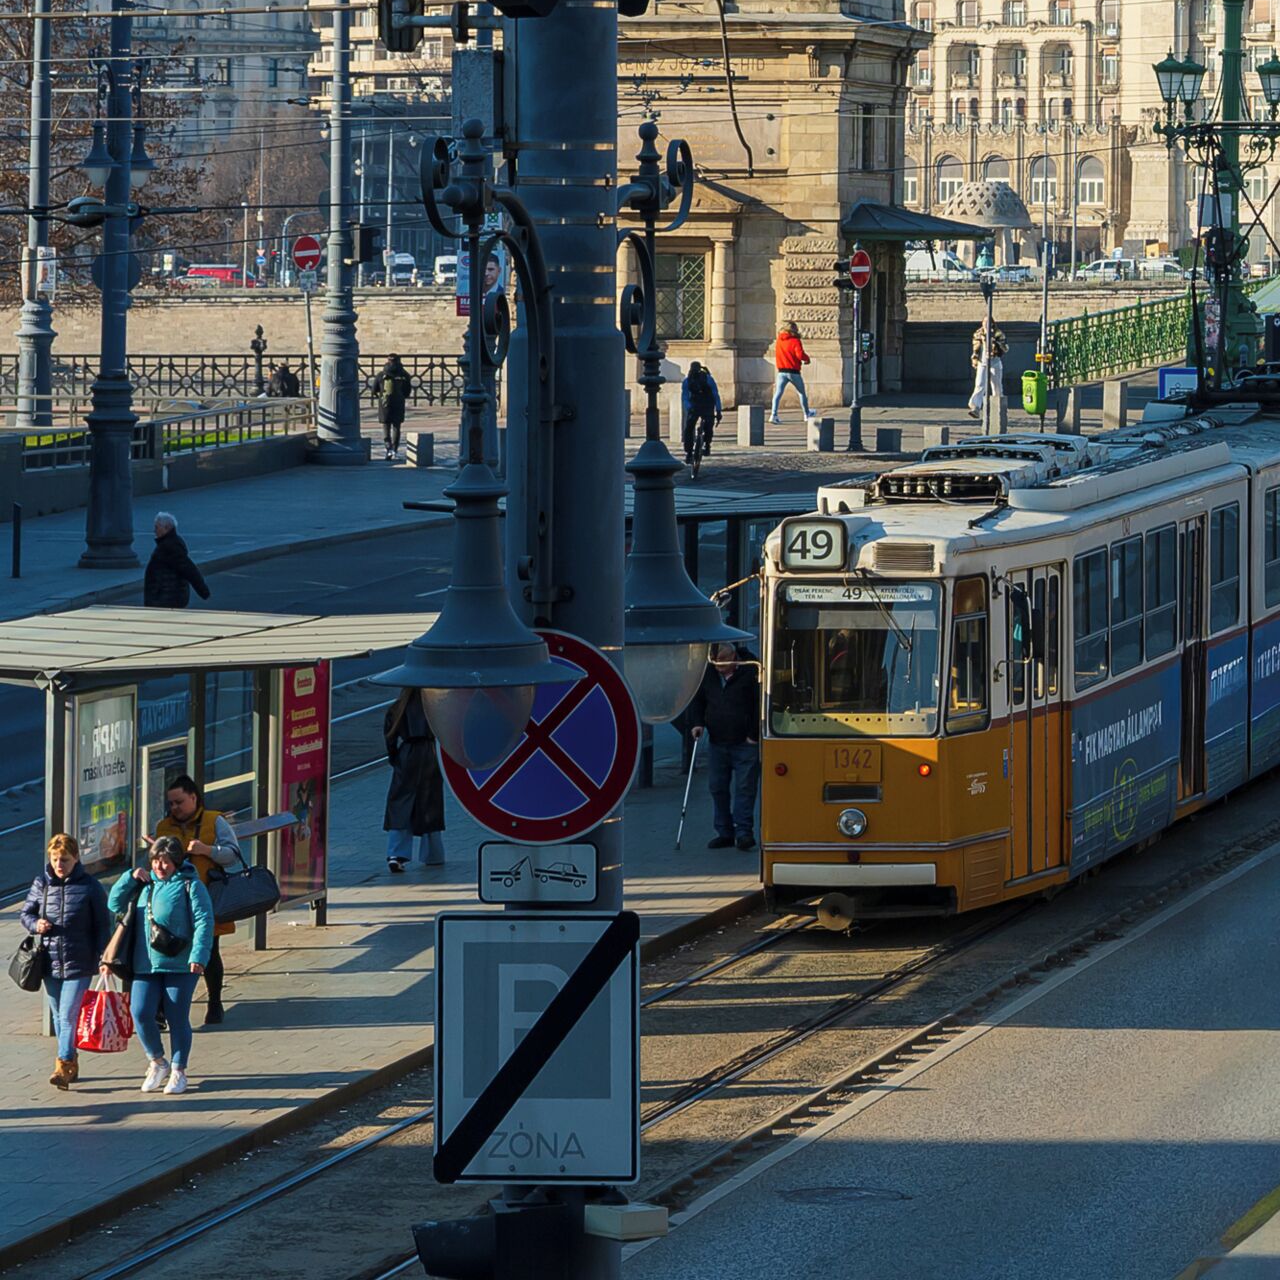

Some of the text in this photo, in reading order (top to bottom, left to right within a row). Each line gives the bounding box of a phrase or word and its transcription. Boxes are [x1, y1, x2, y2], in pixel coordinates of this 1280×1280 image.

[787, 529, 834, 561] 49
[841, 587, 862, 600] 49
[833, 748, 873, 769] 1342
[498, 963, 572, 1072] P
[488, 1122, 586, 1159] ZÓNA
